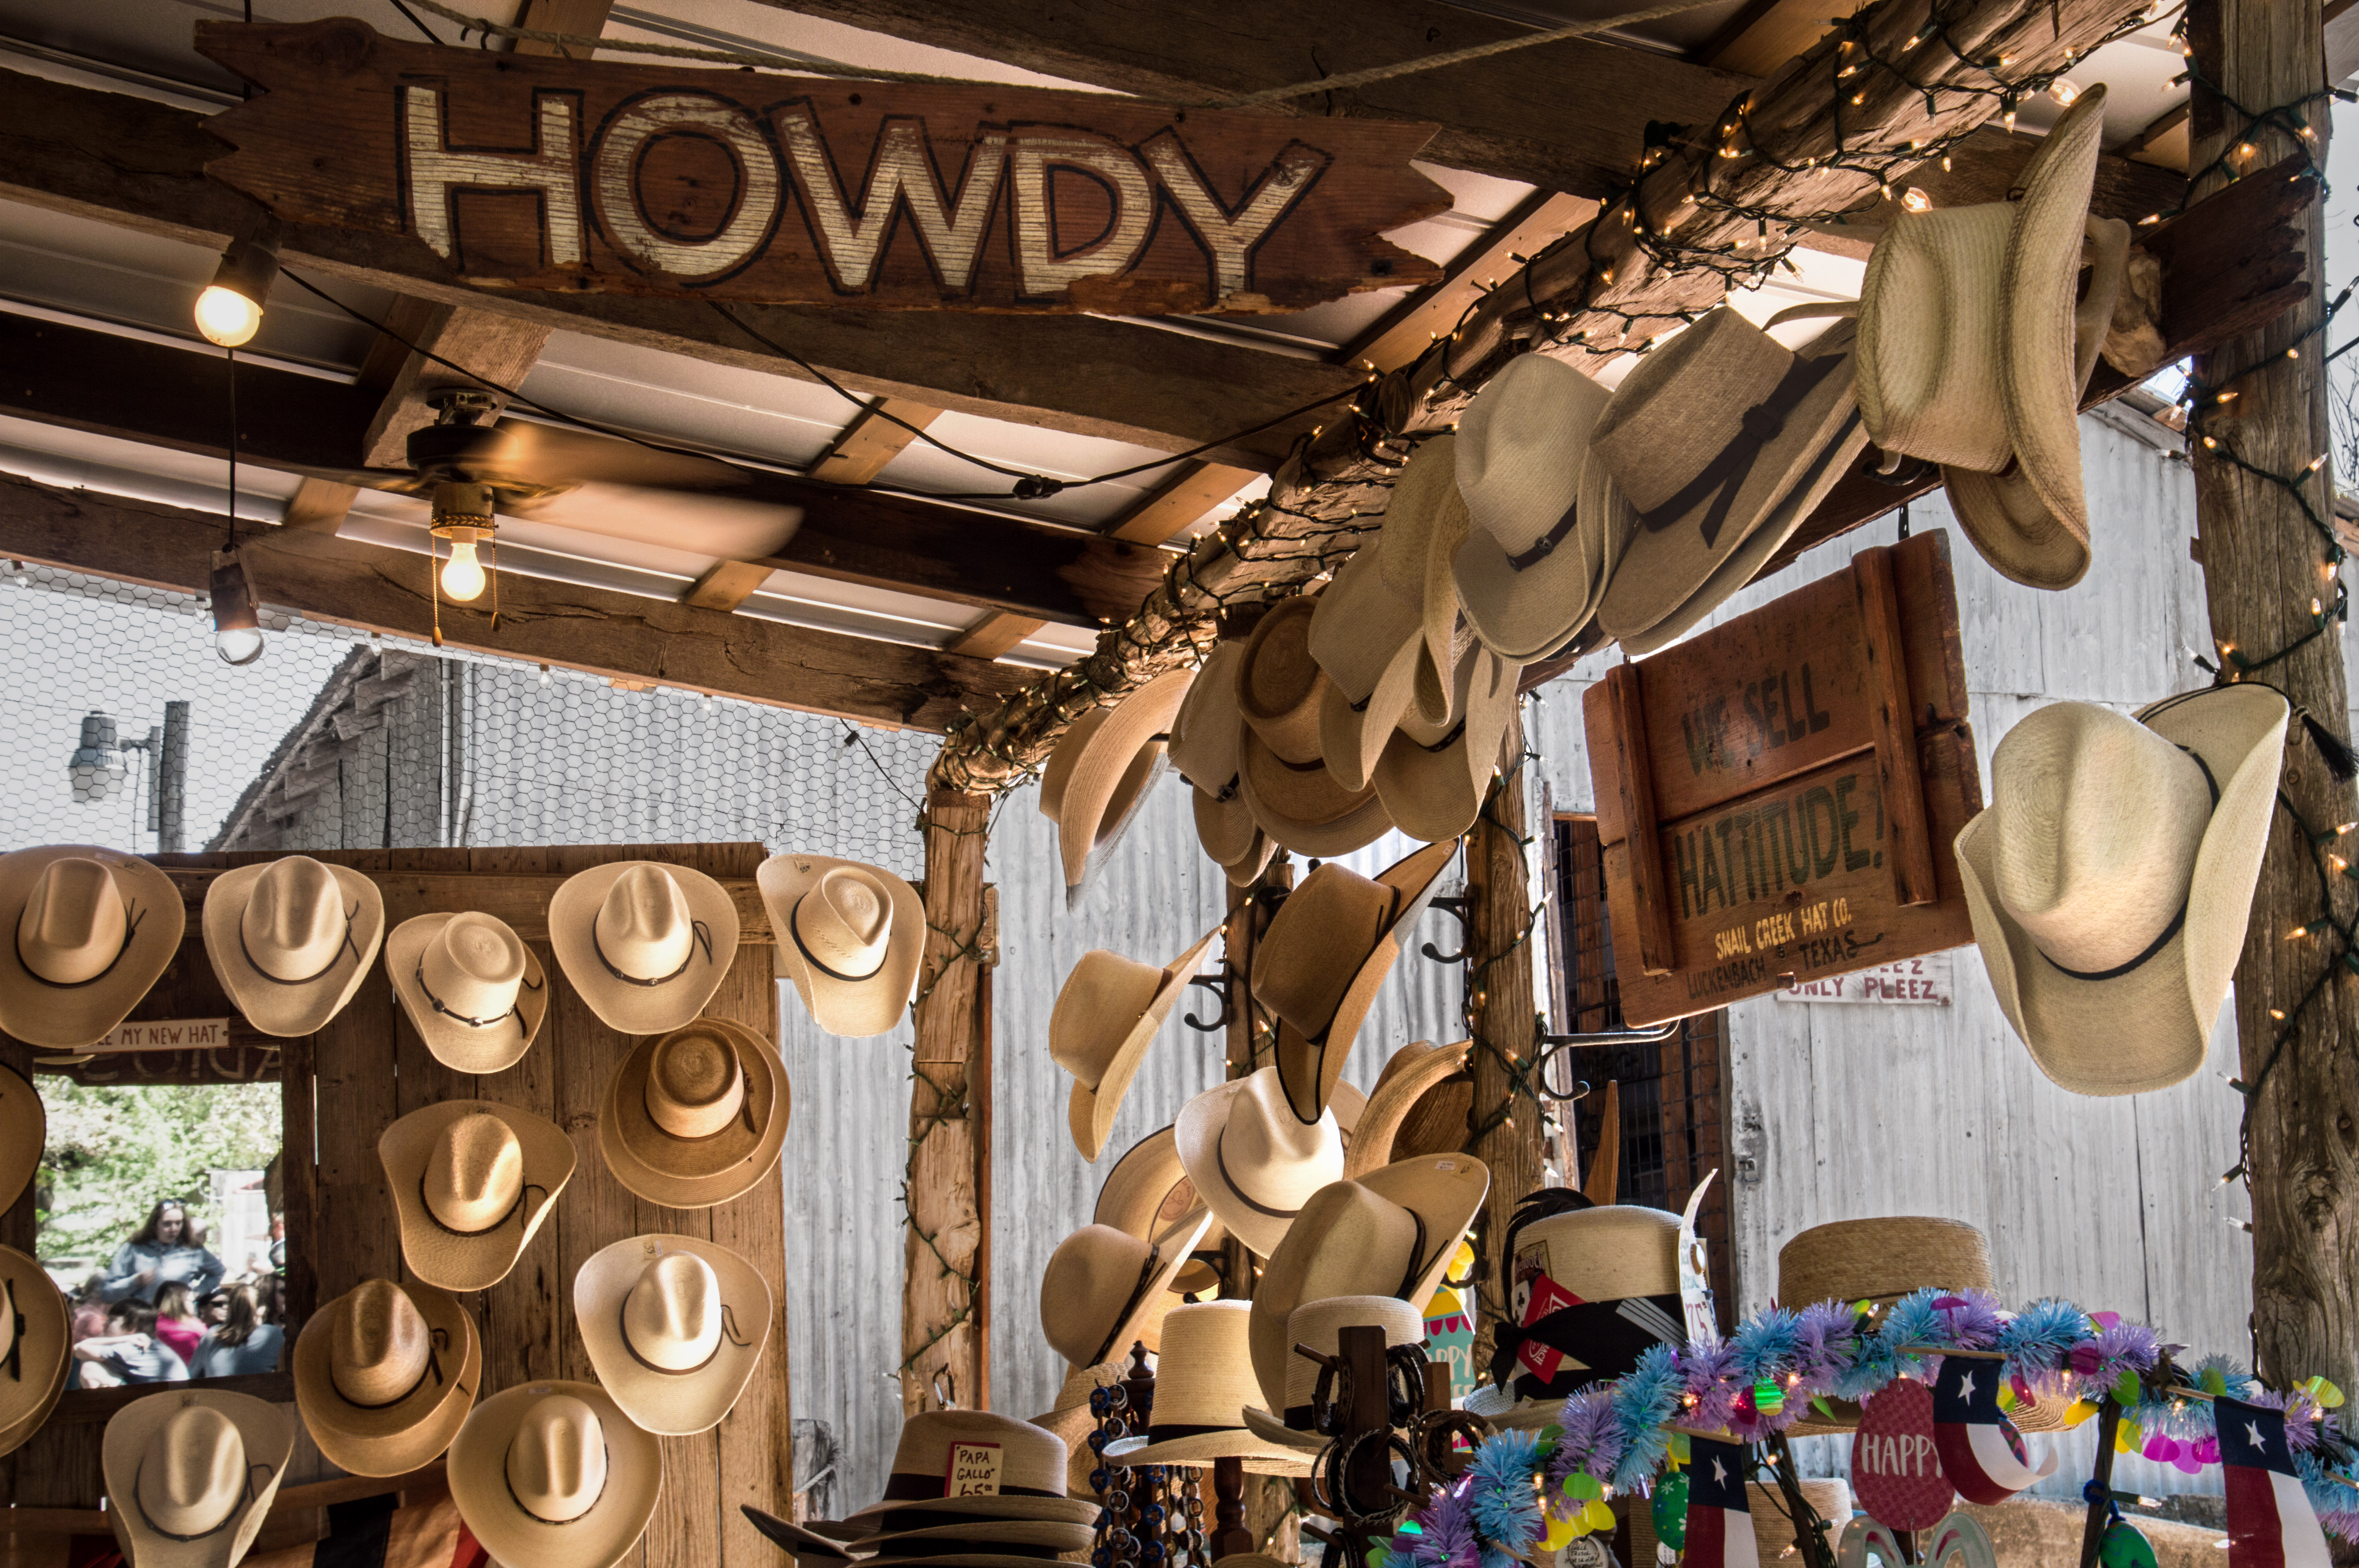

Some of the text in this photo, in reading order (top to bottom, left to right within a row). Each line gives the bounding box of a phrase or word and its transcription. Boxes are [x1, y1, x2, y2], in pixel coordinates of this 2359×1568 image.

[399, 74, 1332, 308] HOWDY
[1681, 662, 1830, 776] WE SELL
[1715, 897, 1852, 960] SNAIL CREEK HAT CO.
[1687, 929, 1862, 1000] LUCKENBACH TEXAS
[1864, 977, 1938, 1000] PLEEZ
[121, 1028, 142, 1046] MY
[149, 1027, 183, 1045] NEW
[189, 1024, 218, 1044] HAT
